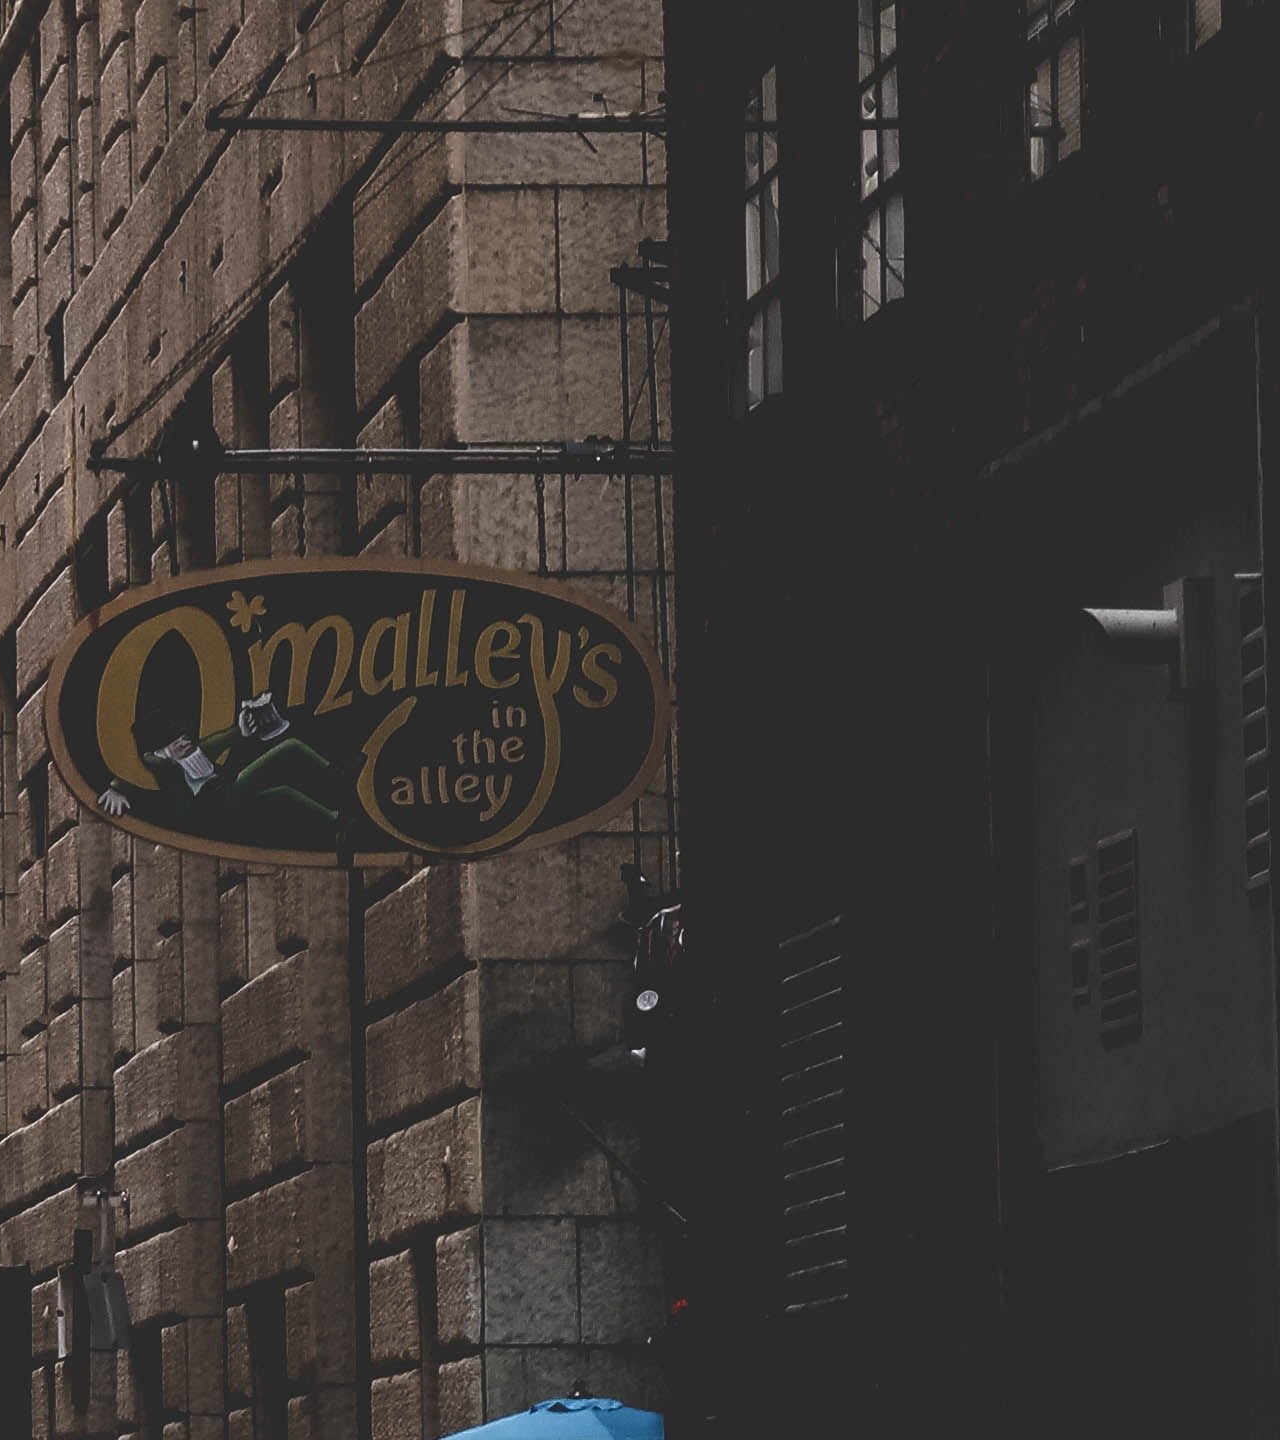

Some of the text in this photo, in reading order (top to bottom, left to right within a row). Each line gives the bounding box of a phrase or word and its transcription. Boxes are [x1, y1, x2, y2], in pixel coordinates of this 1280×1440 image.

[490, 699, 528, 729] in
[452, 727, 526, 763] the
[390, 766, 514, 822] alley
